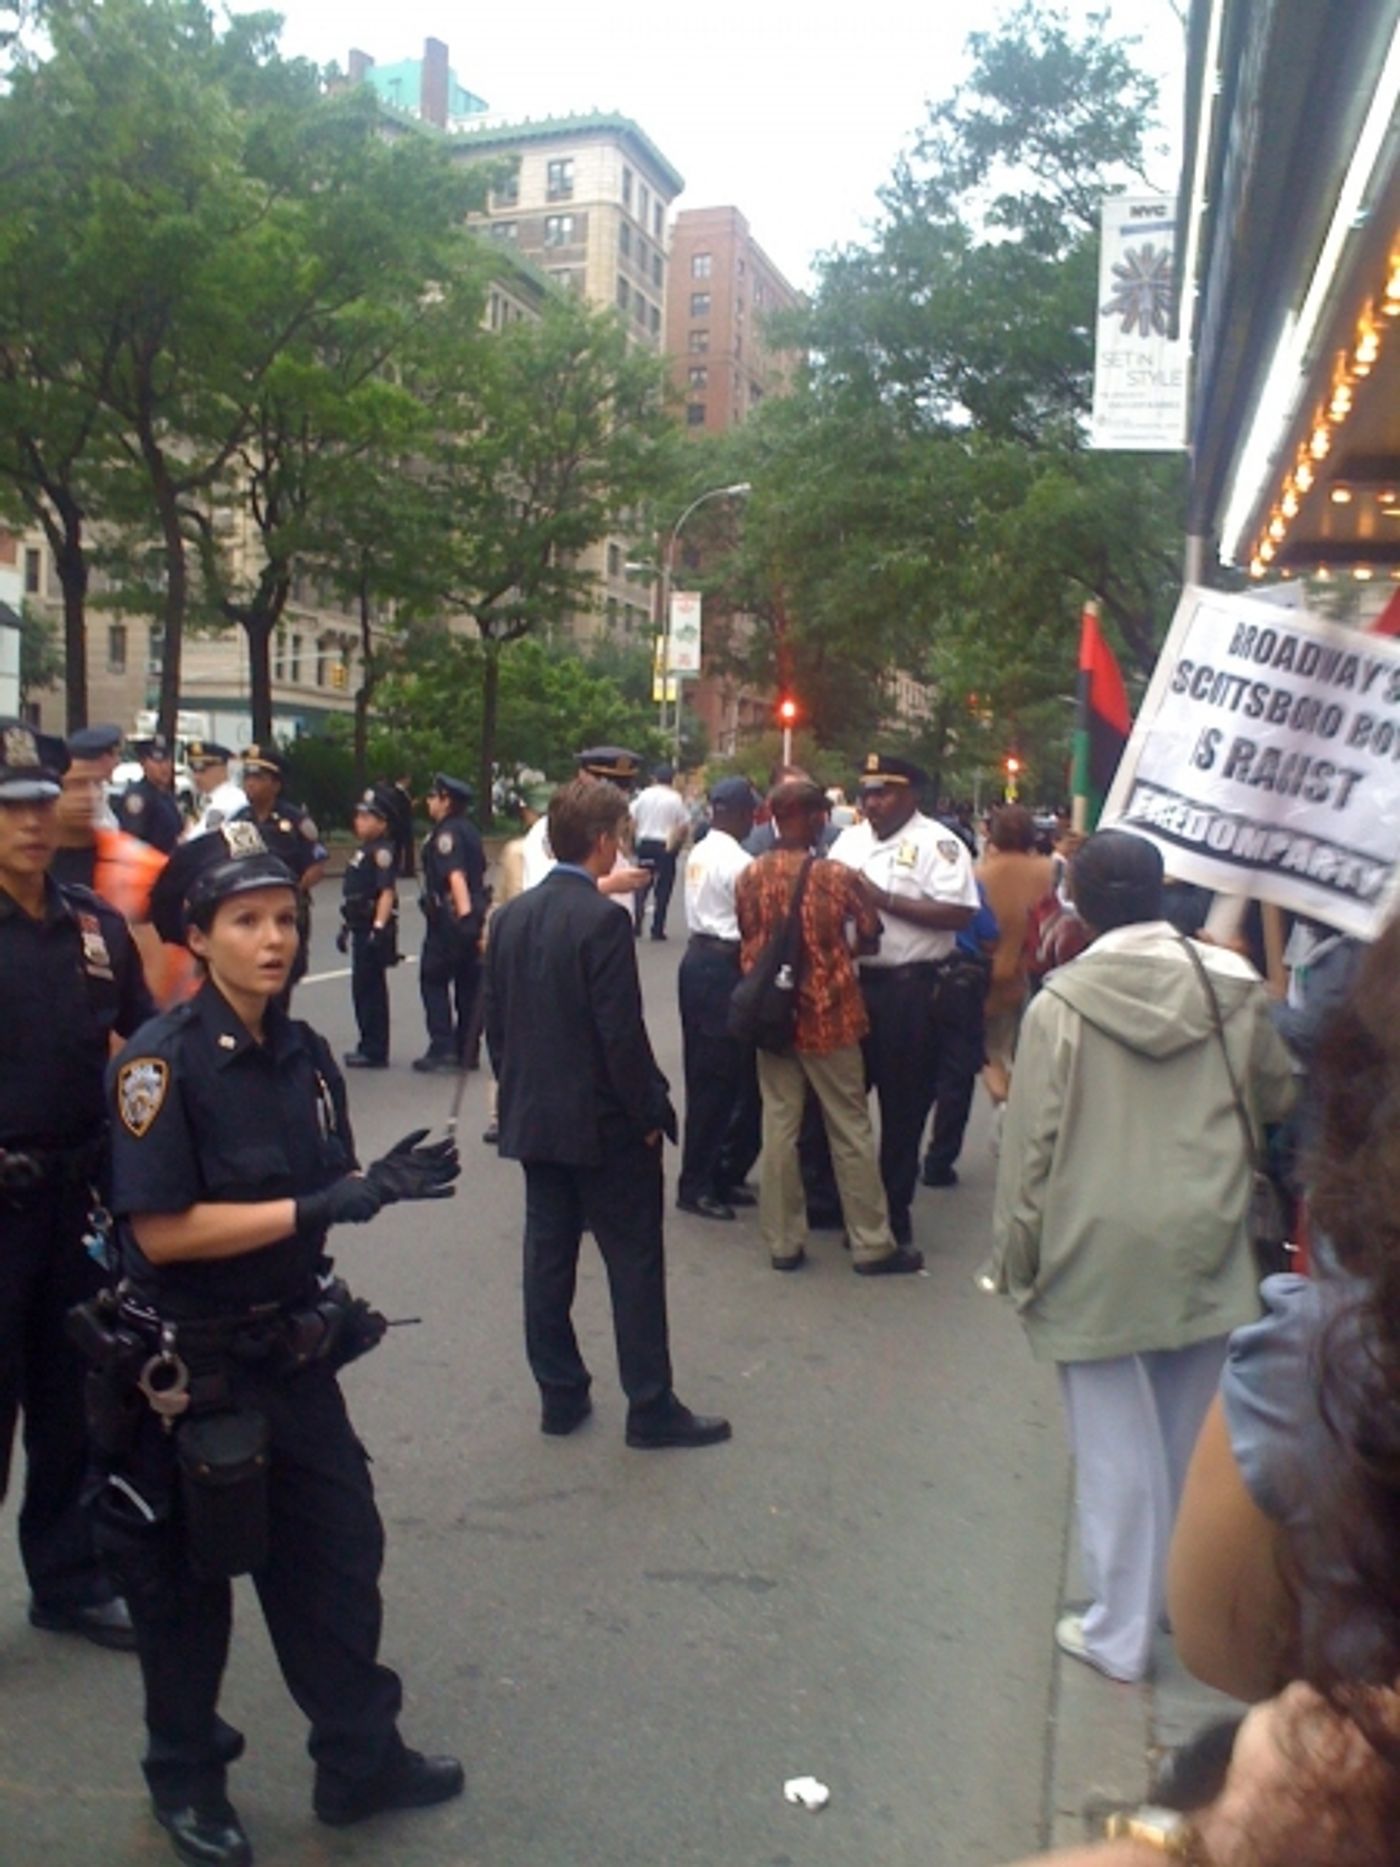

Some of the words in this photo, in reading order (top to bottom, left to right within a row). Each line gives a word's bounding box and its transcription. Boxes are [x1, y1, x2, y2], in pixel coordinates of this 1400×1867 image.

[1130, 204, 1167, 218] NYC
[1102, 351, 1133, 368] SET
[1126, 370, 1182, 387] STYLE
